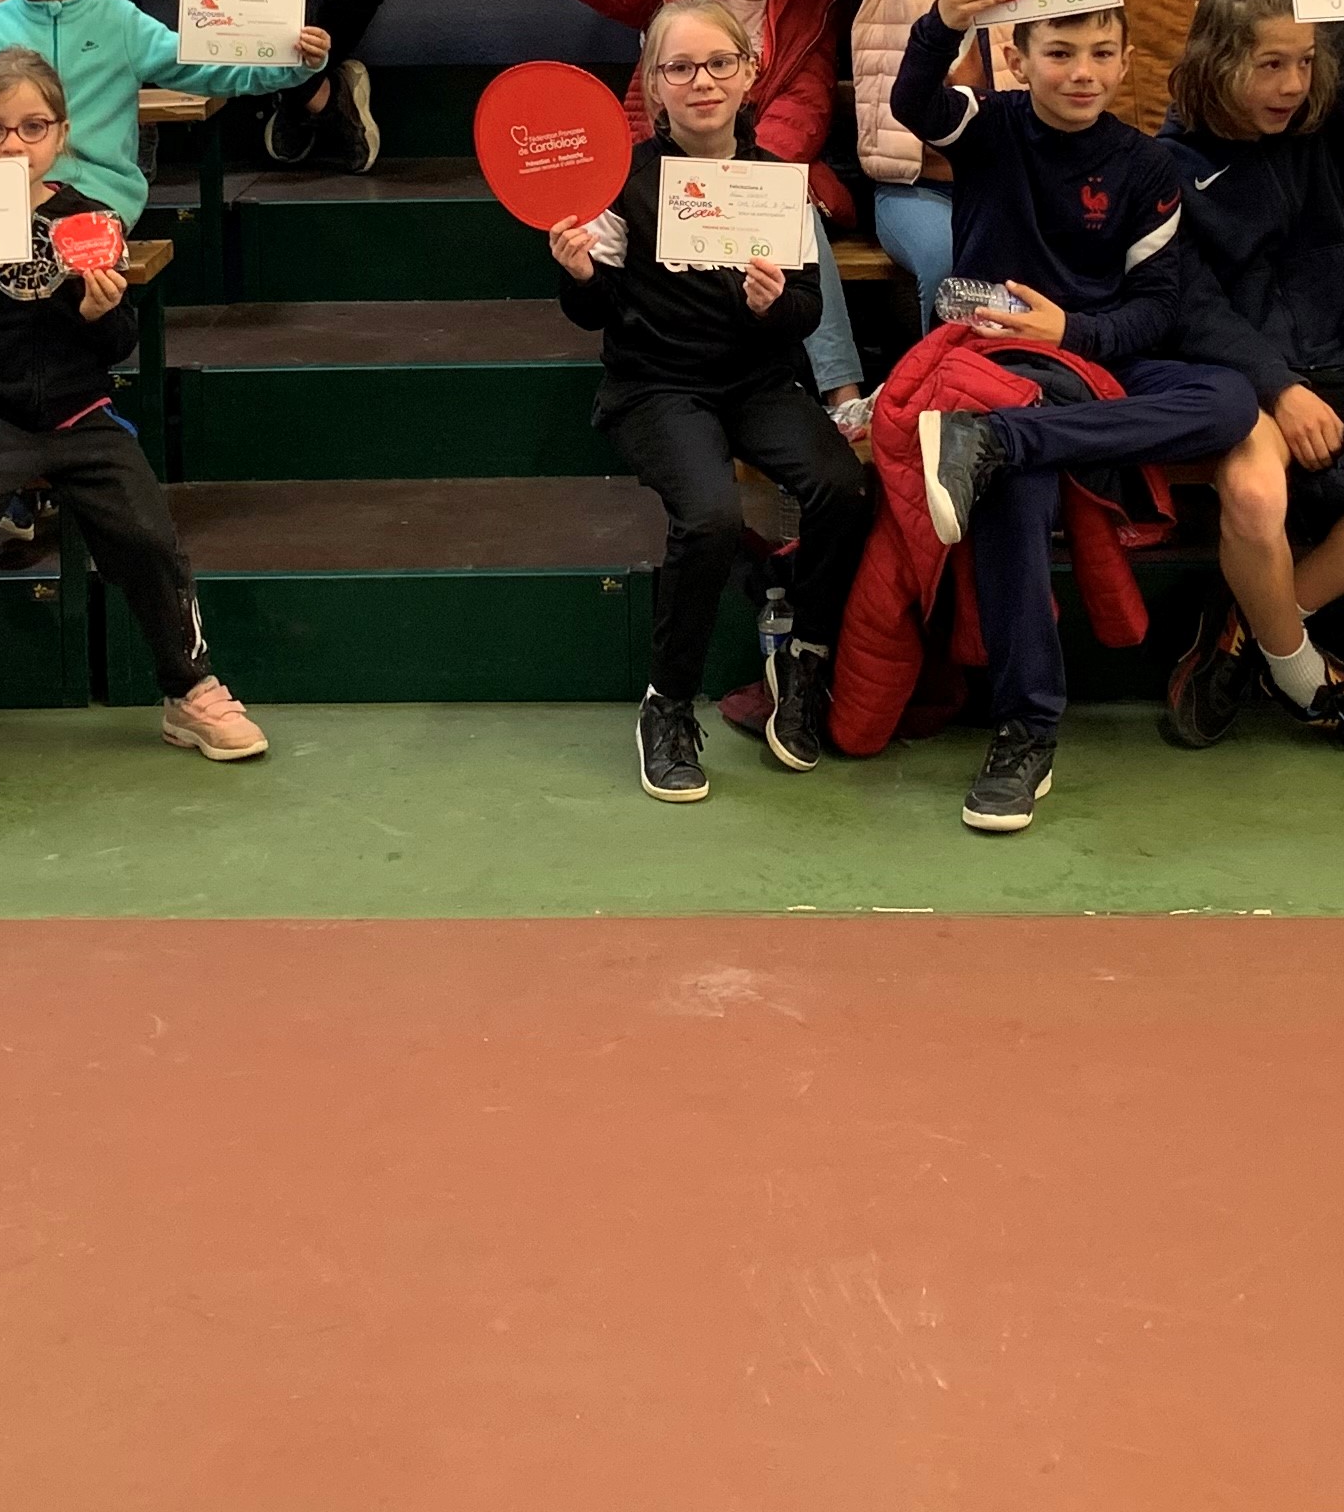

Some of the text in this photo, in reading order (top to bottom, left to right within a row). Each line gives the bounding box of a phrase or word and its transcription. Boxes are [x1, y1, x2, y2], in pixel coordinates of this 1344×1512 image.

[258, 47, 274, 58] 60
[529, 134, 588, 154] Cardiologie
[668, 200, 713, 208] PARCOURS
[724, 242, 733, 255] 5
[751, 244, 770, 257] 60
